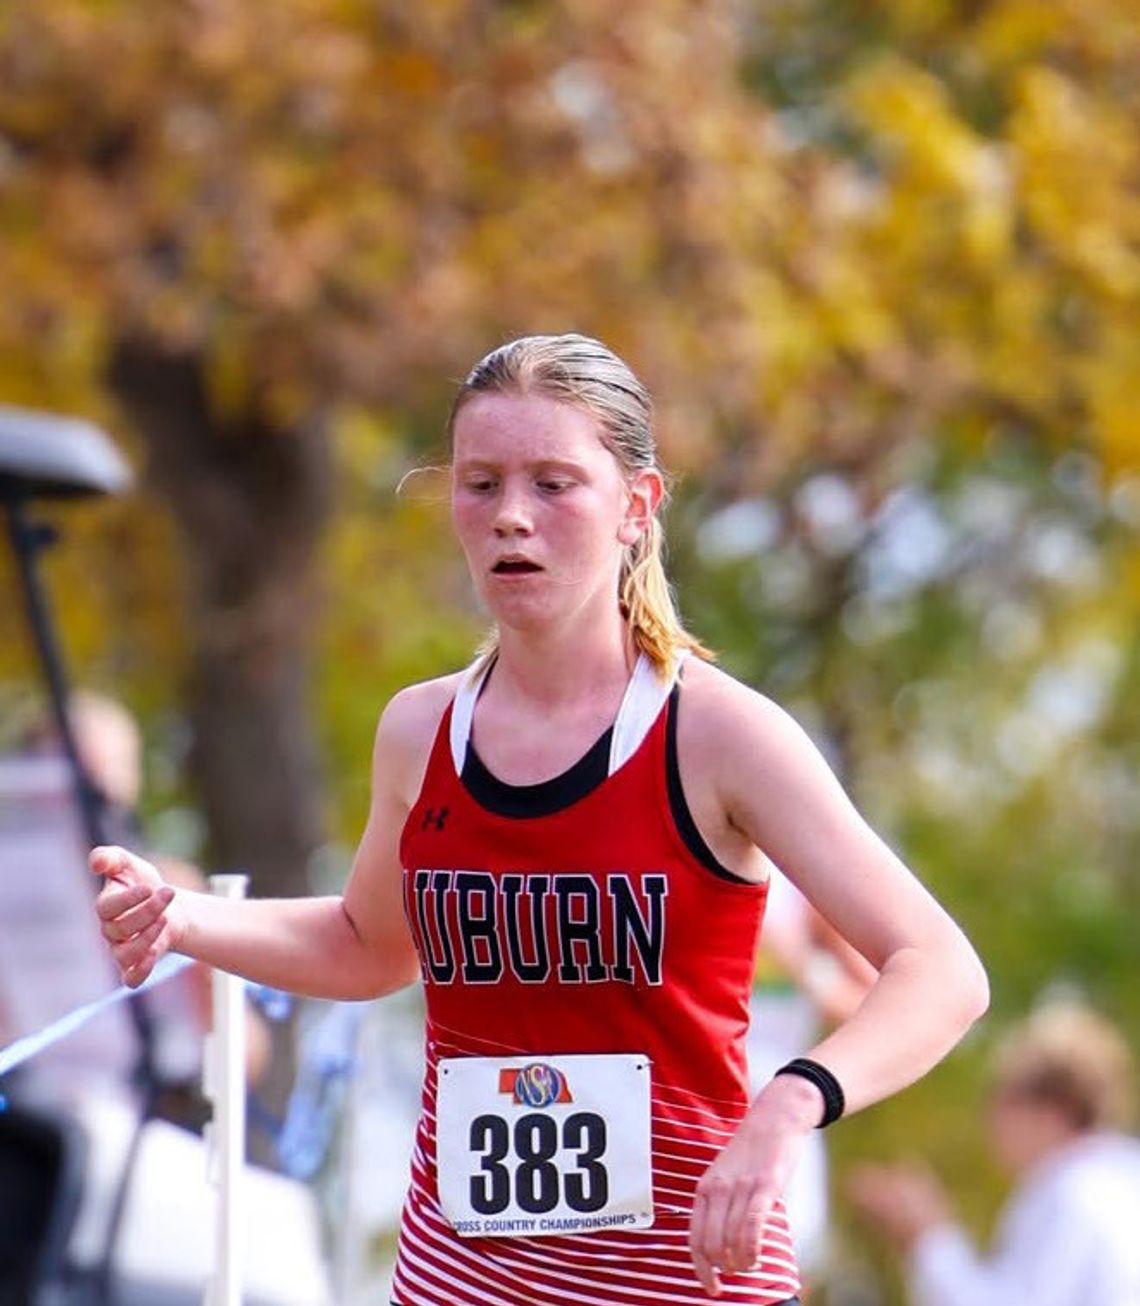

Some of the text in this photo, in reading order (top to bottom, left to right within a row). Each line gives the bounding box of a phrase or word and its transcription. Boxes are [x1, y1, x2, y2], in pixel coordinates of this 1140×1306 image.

[404, 869, 668, 986] UBURN
[469, 1112, 609, 1215] 383
[484, 1219, 535, 1232] COUNTRY
[540, 1214, 636, 1230] CHAMPIONSHIPS
